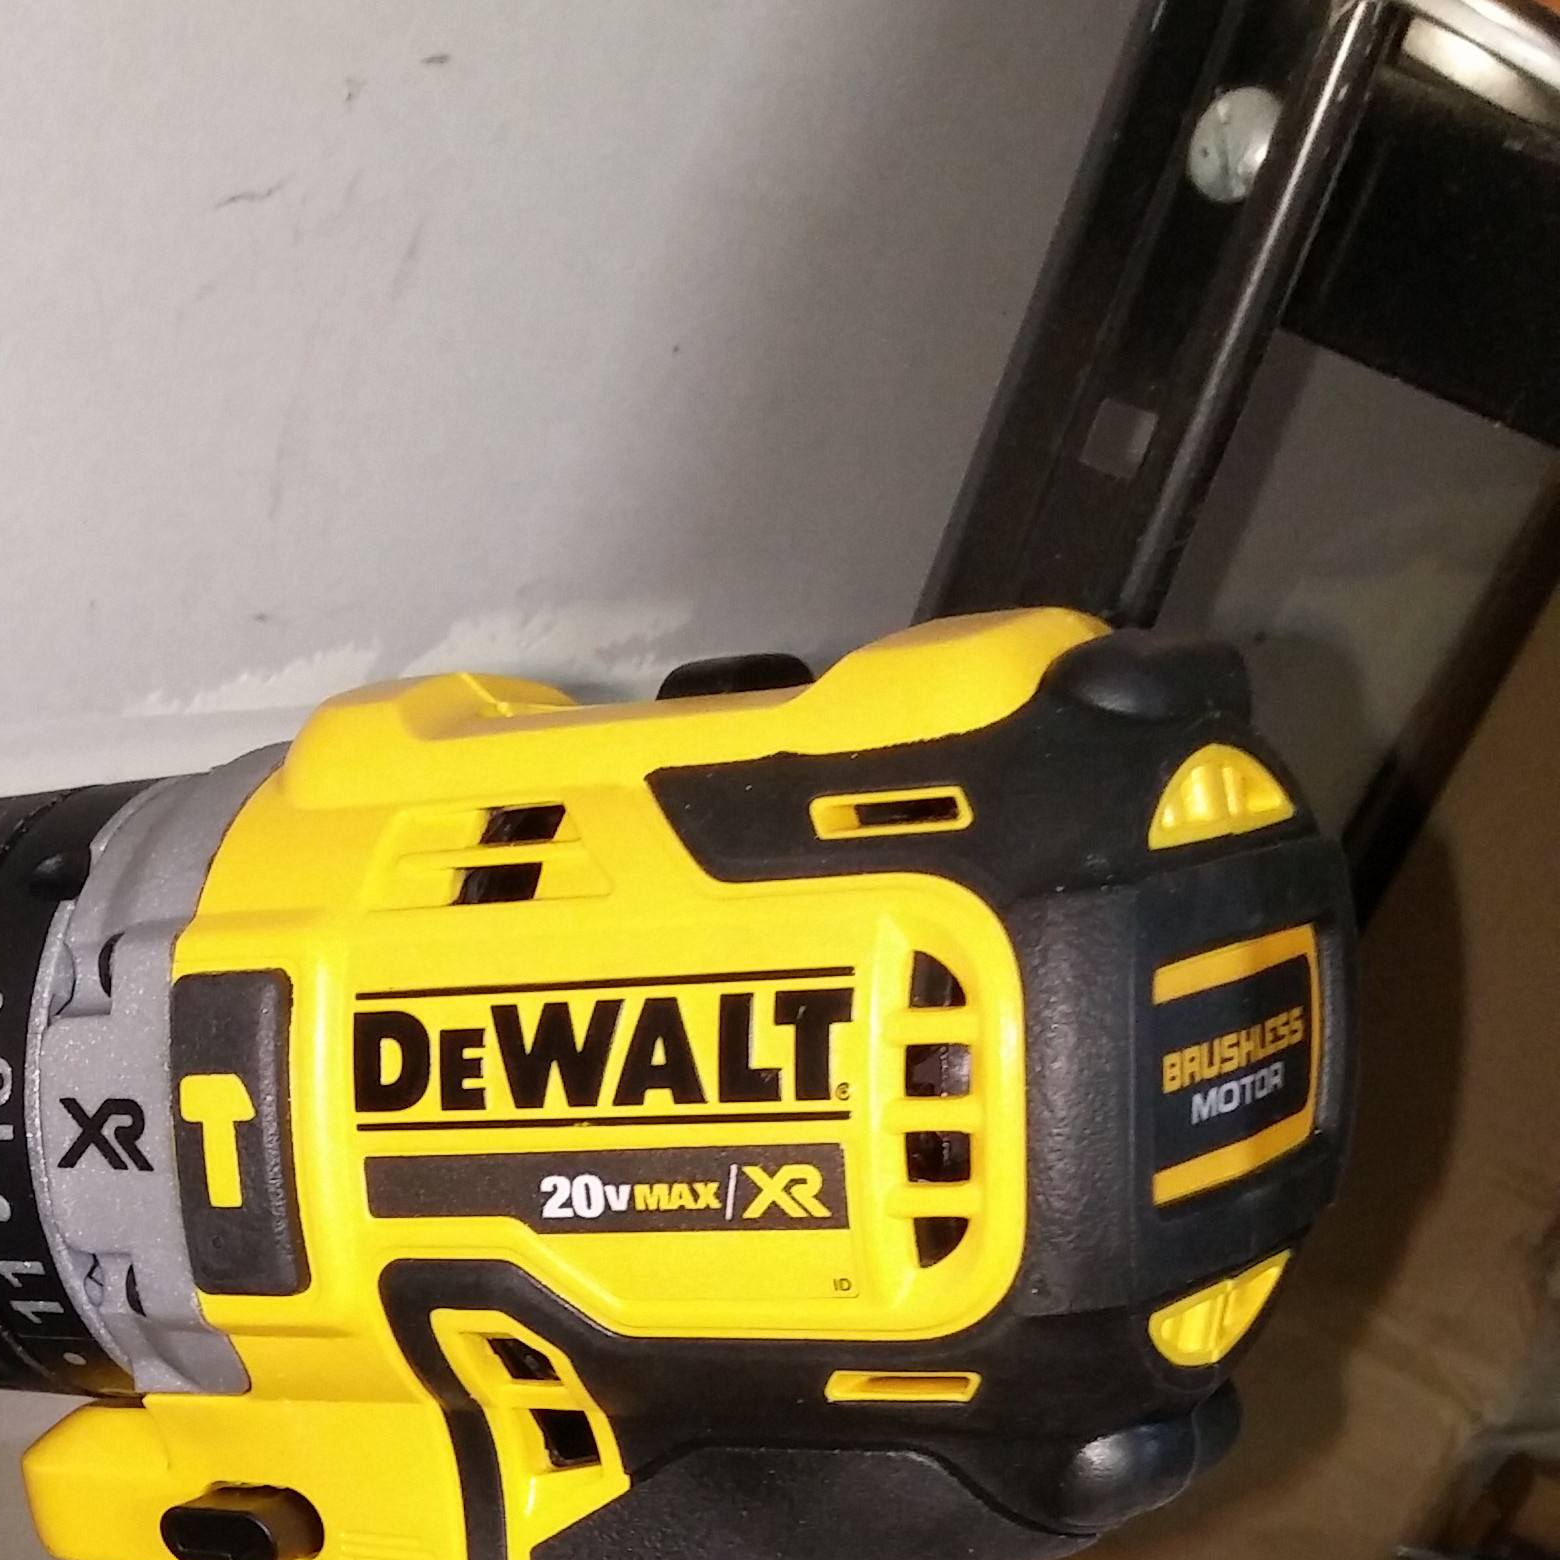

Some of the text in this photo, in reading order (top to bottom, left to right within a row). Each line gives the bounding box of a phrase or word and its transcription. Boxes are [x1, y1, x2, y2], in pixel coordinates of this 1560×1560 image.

[1162, 1005, 1305, 1094] BRUSHLESS
[1191, 1061, 1285, 1125] MOTOR
[57, 1097, 154, 1171] XR
[634, 1181, 723, 1211] MAX
[742, 1163, 833, 1219] XR
